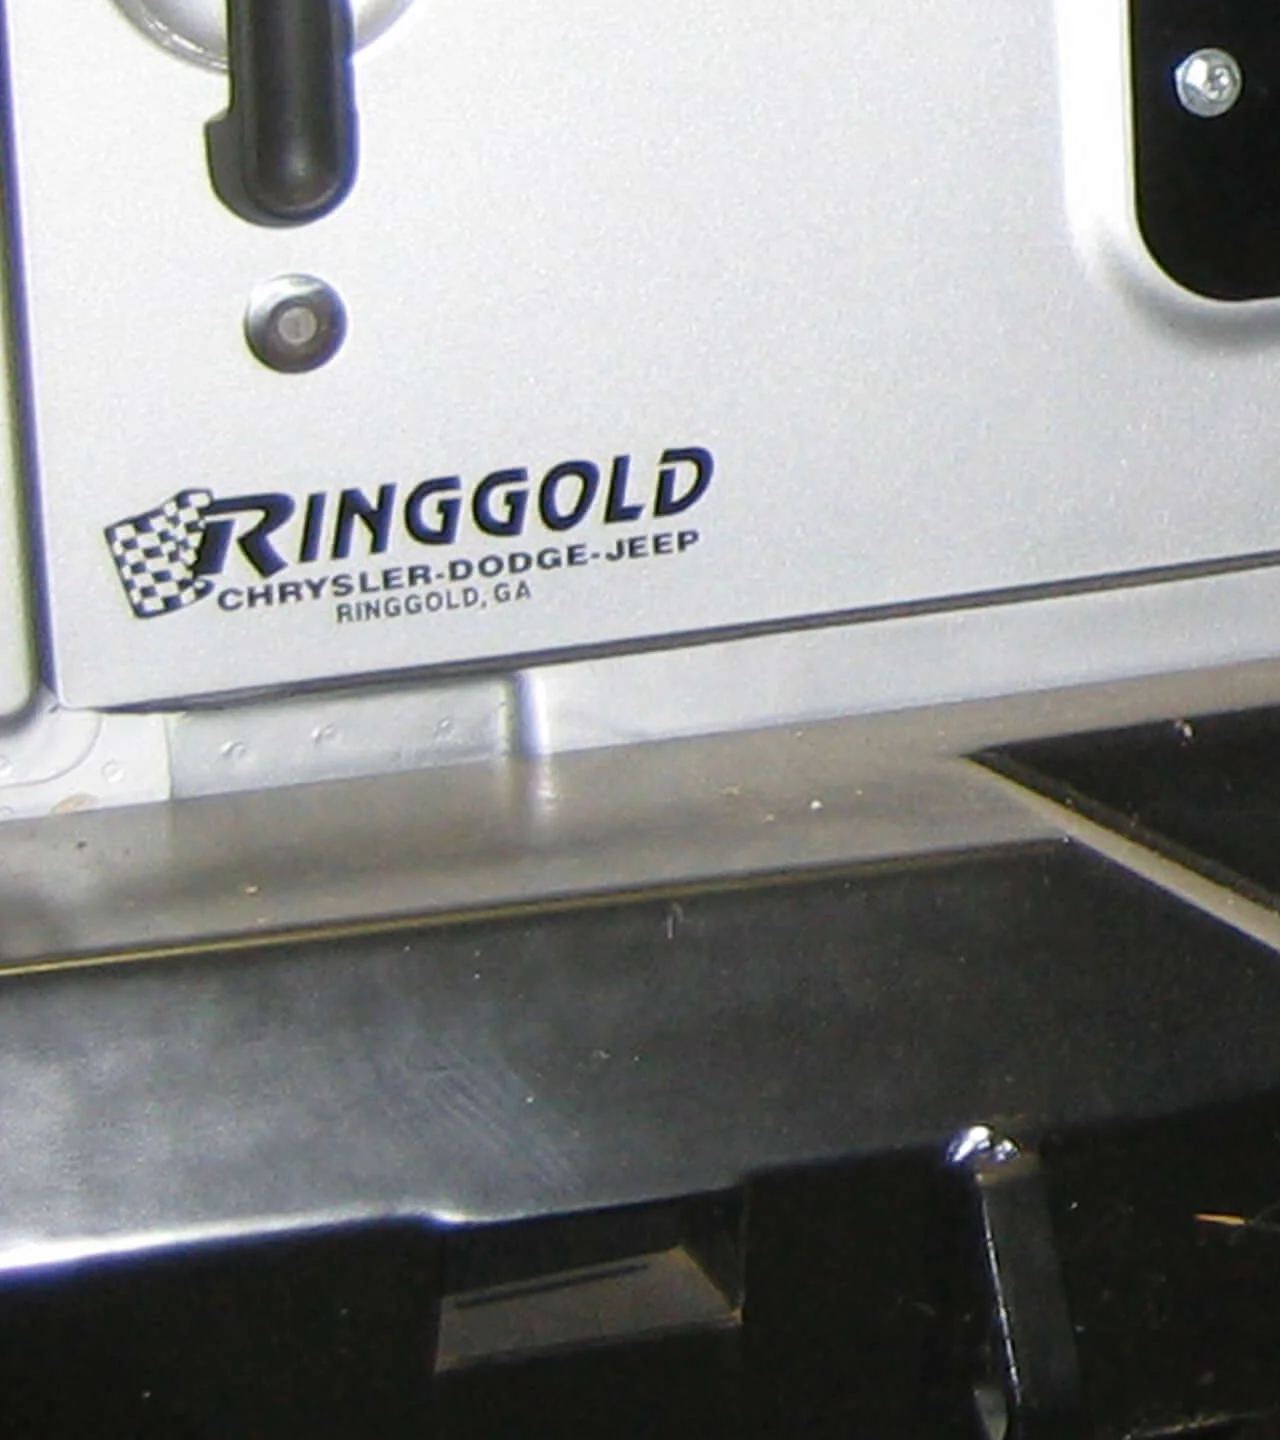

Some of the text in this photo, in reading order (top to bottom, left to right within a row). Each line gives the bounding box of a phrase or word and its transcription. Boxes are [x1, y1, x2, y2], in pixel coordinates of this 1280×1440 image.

[189, 445, 716, 578] RINGGOLD
[216, 528, 702, 613] CHRYSLER-DODGE-JEEP
[335, 582, 534, 625] RINGGOLD, GA
